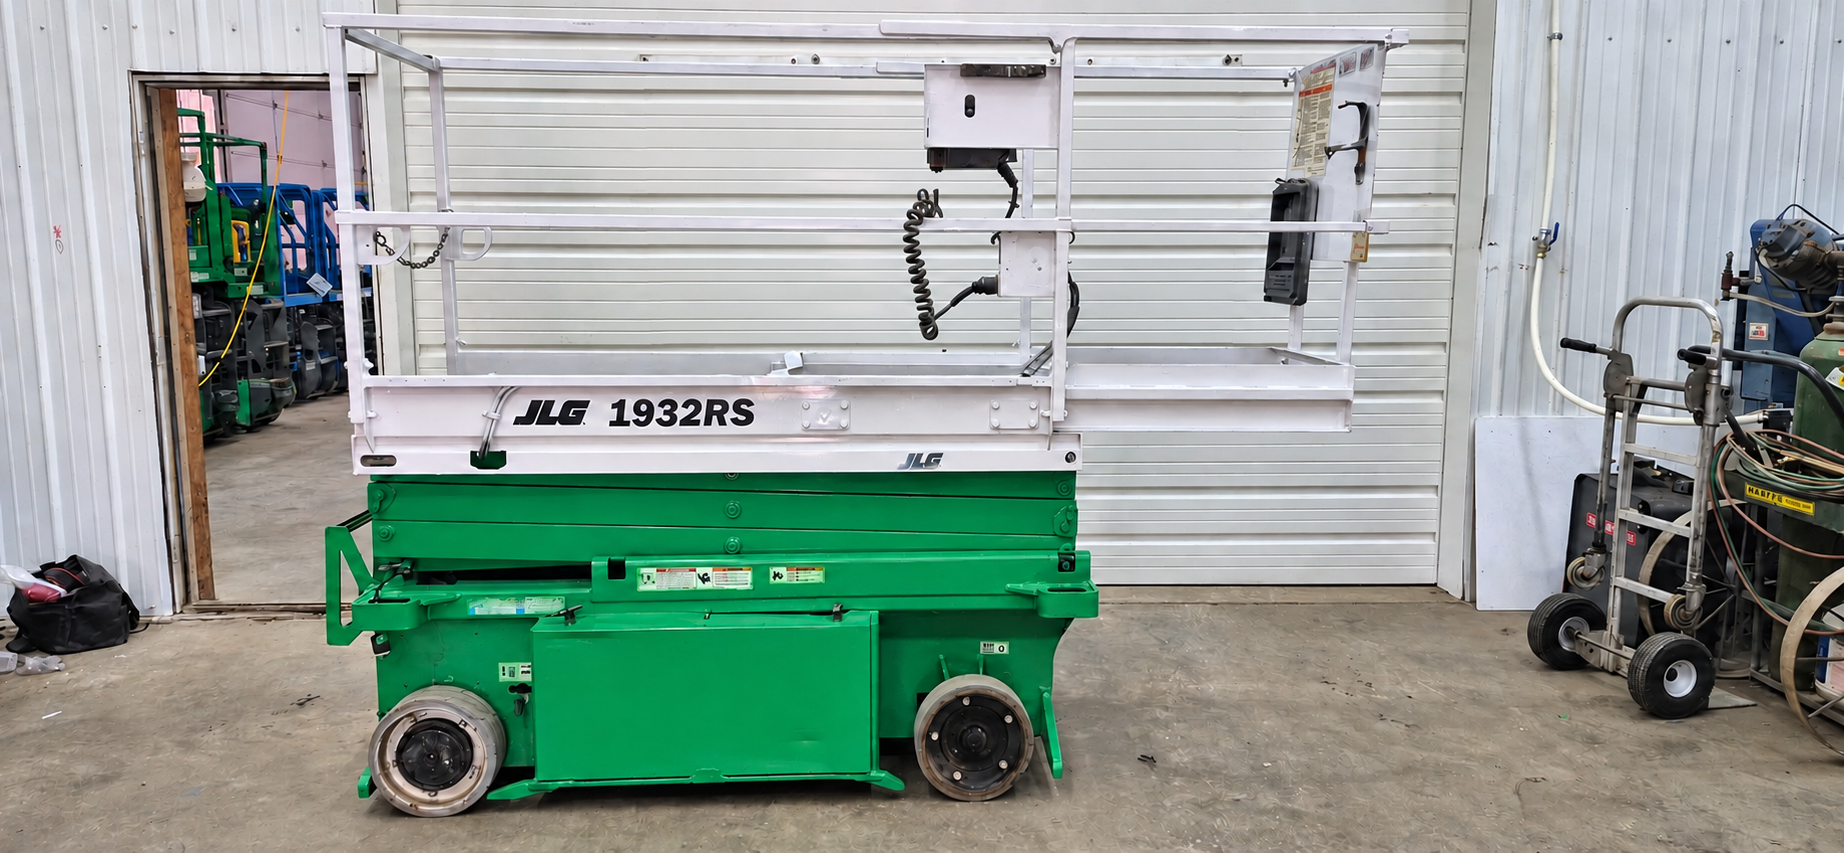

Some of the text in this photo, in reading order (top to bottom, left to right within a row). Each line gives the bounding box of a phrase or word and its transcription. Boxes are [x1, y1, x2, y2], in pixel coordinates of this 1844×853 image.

[513, 398, 756, 427] JLG 1932RS
[897, 452, 944, 470] JLG
